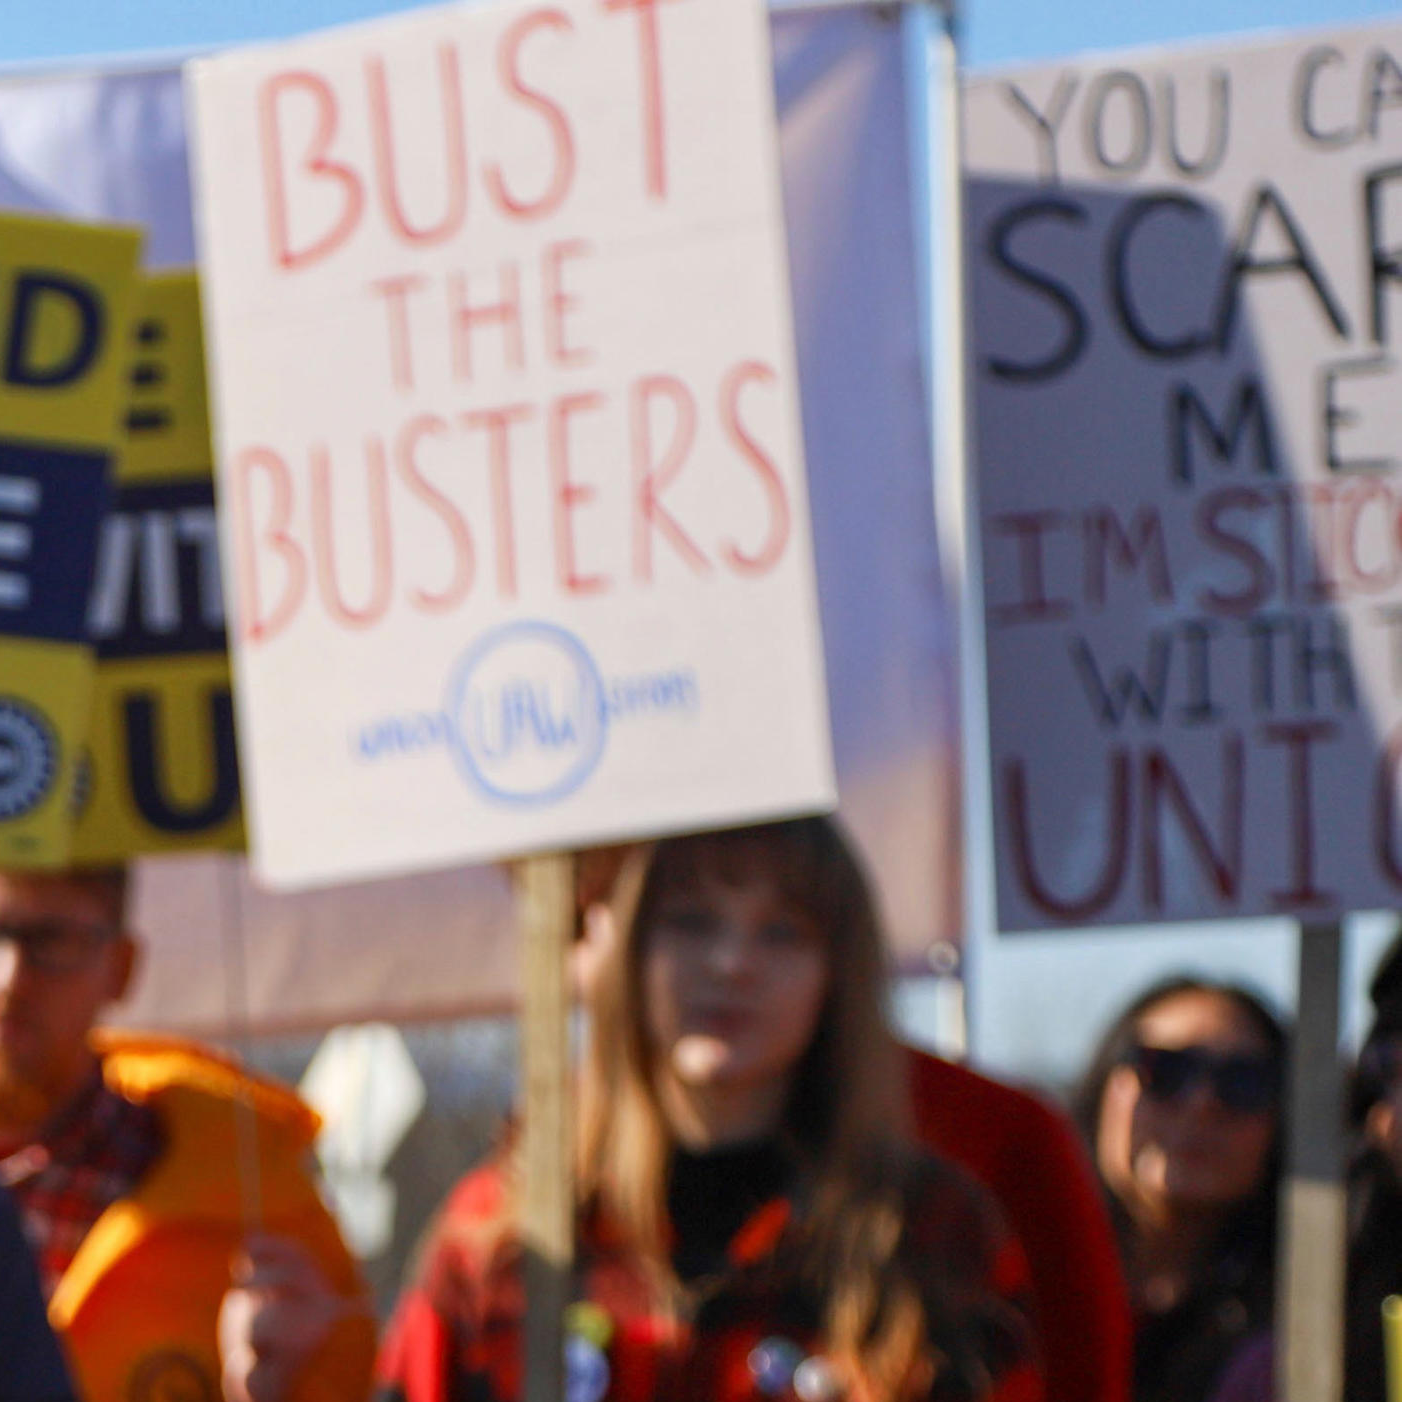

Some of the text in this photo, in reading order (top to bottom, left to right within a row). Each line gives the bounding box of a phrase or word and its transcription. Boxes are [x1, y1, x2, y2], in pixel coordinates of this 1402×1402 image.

[259, 0, 681, 269] BUST
[1005, 69, 1228, 190] YOU
[374, 239, 598, 390] THE
[1168, 348, 1398, 487] ME
[232, 360, 794, 646] BUSTERS
[1069, 612, 1359, 729] WITH
